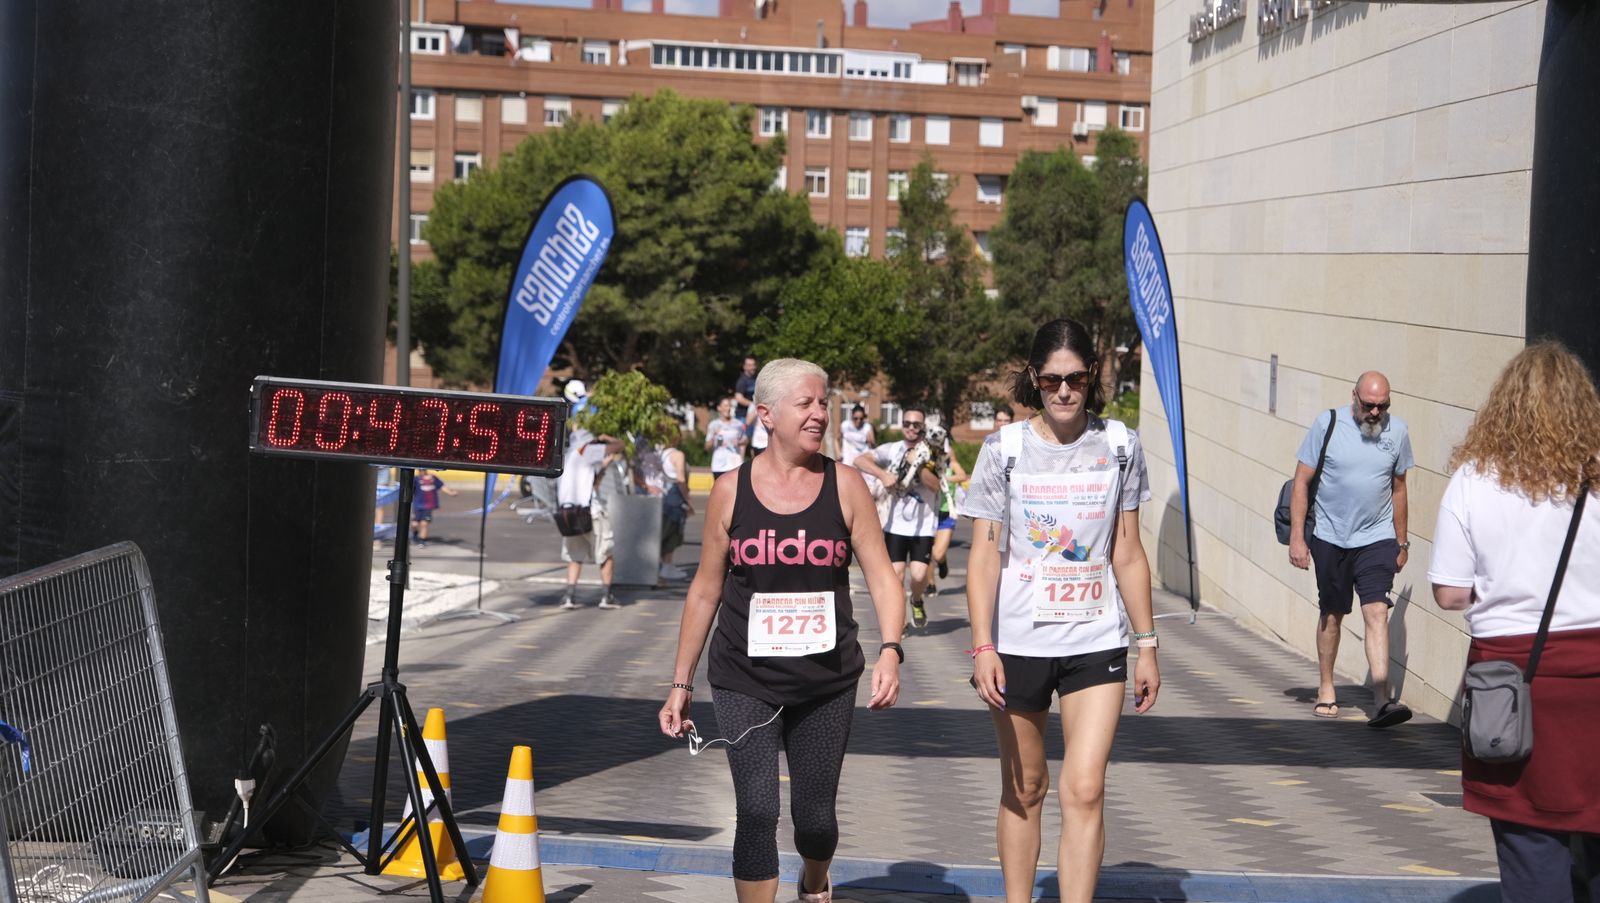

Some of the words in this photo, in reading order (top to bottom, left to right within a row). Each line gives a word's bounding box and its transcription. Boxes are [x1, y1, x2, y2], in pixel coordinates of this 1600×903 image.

[268, 388, 549, 462] 00:47:54
[730, 529, 847, 567] adidas
[1045, 581, 1103, 602] 1270
[762, 614, 827, 635] 1273
